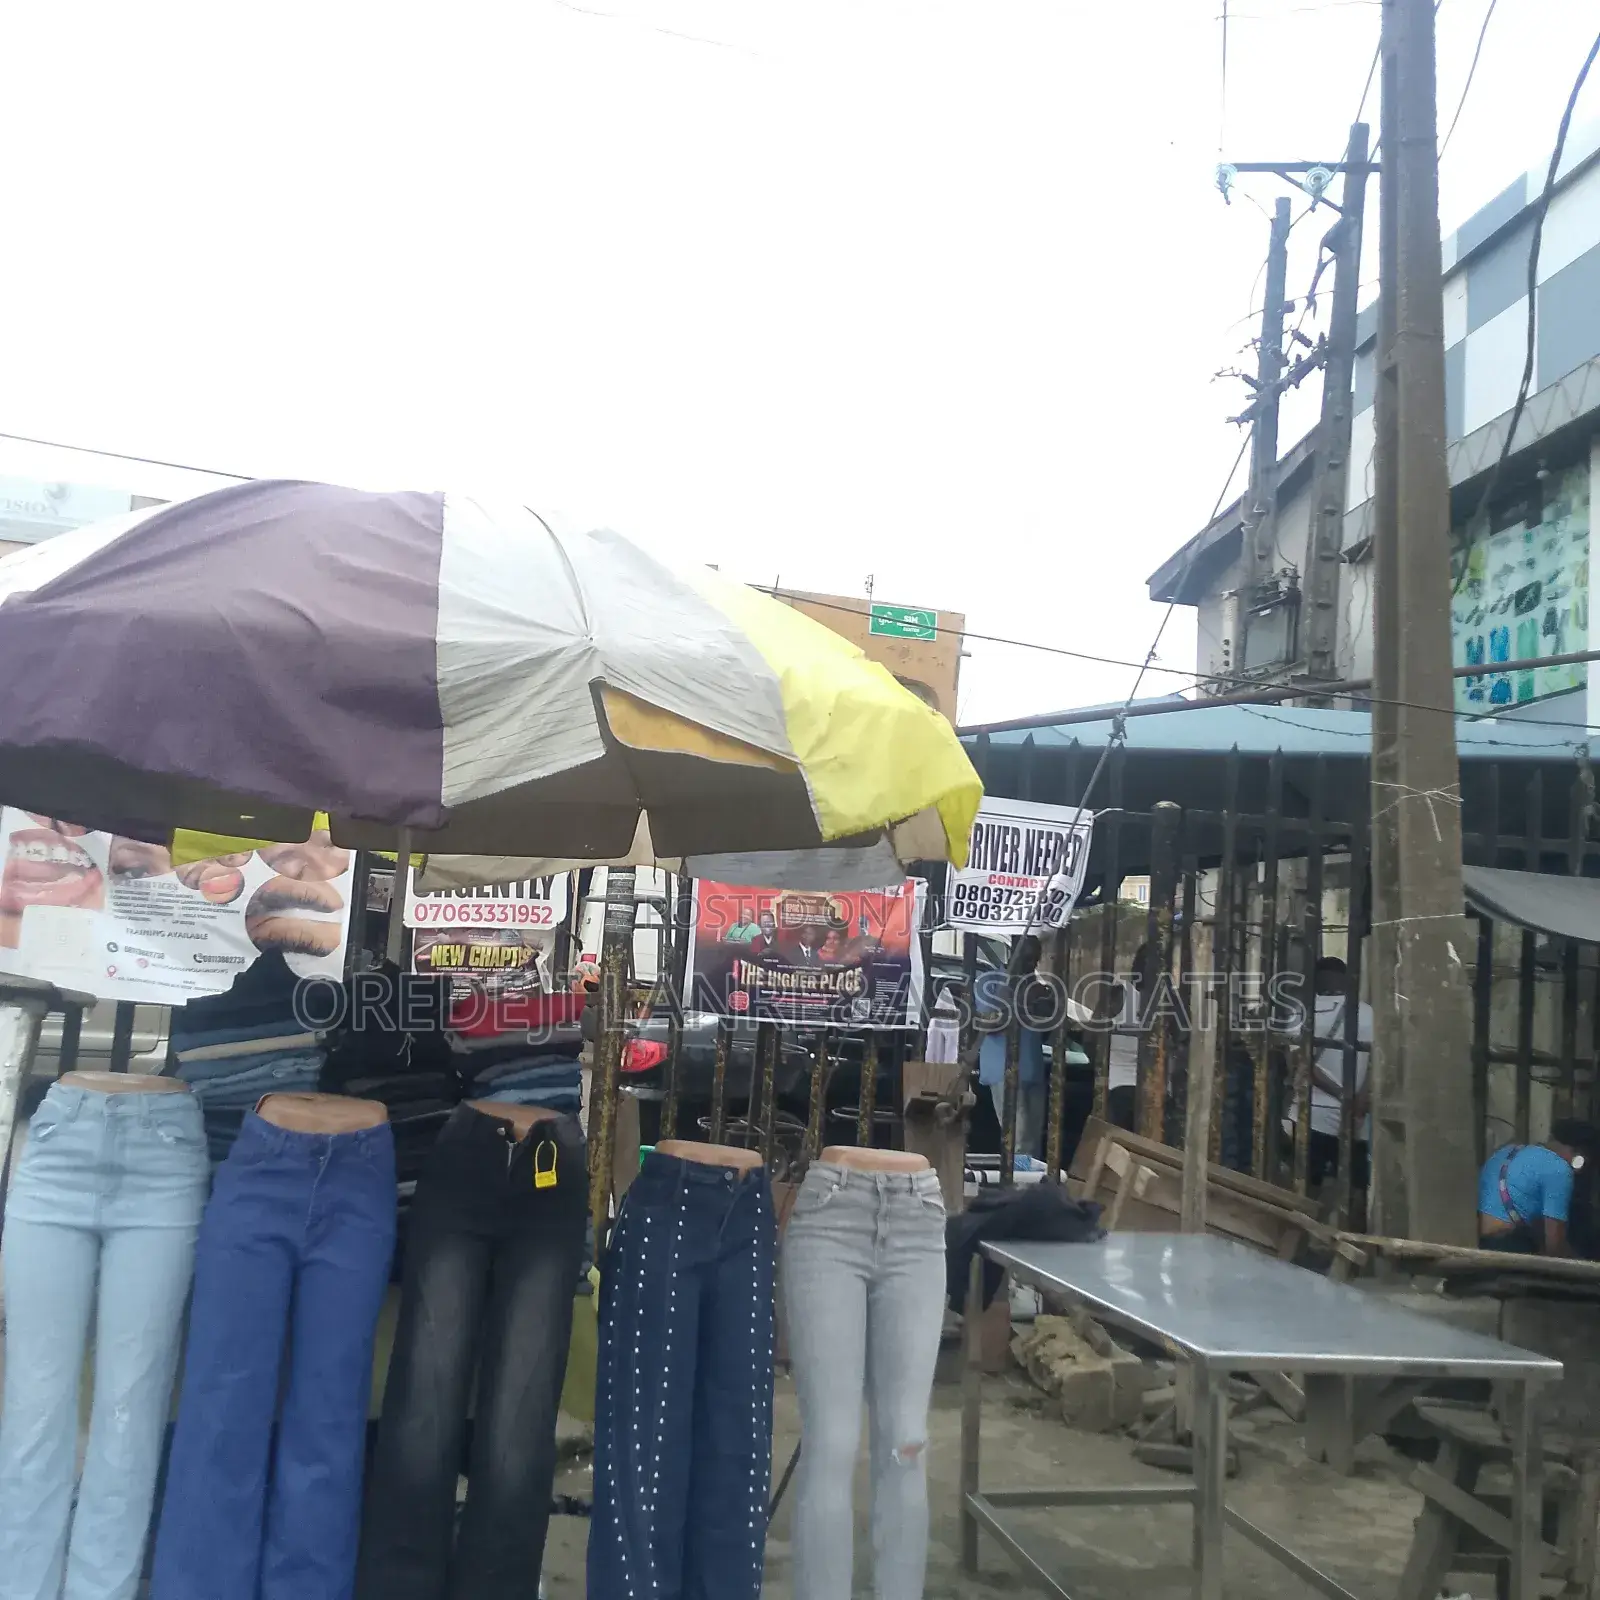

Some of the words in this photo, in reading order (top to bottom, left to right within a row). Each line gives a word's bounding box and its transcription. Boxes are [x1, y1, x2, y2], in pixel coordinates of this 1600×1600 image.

[967, 823, 1020, 874] RIVER
[988, 874, 1046, 889] CONTACT
[414, 903, 553, 924] 07063331952
[430, 943, 466, 967] NEW
[740, 959, 766, 987] THE
[767, 970, 820, 990] HIGHER
